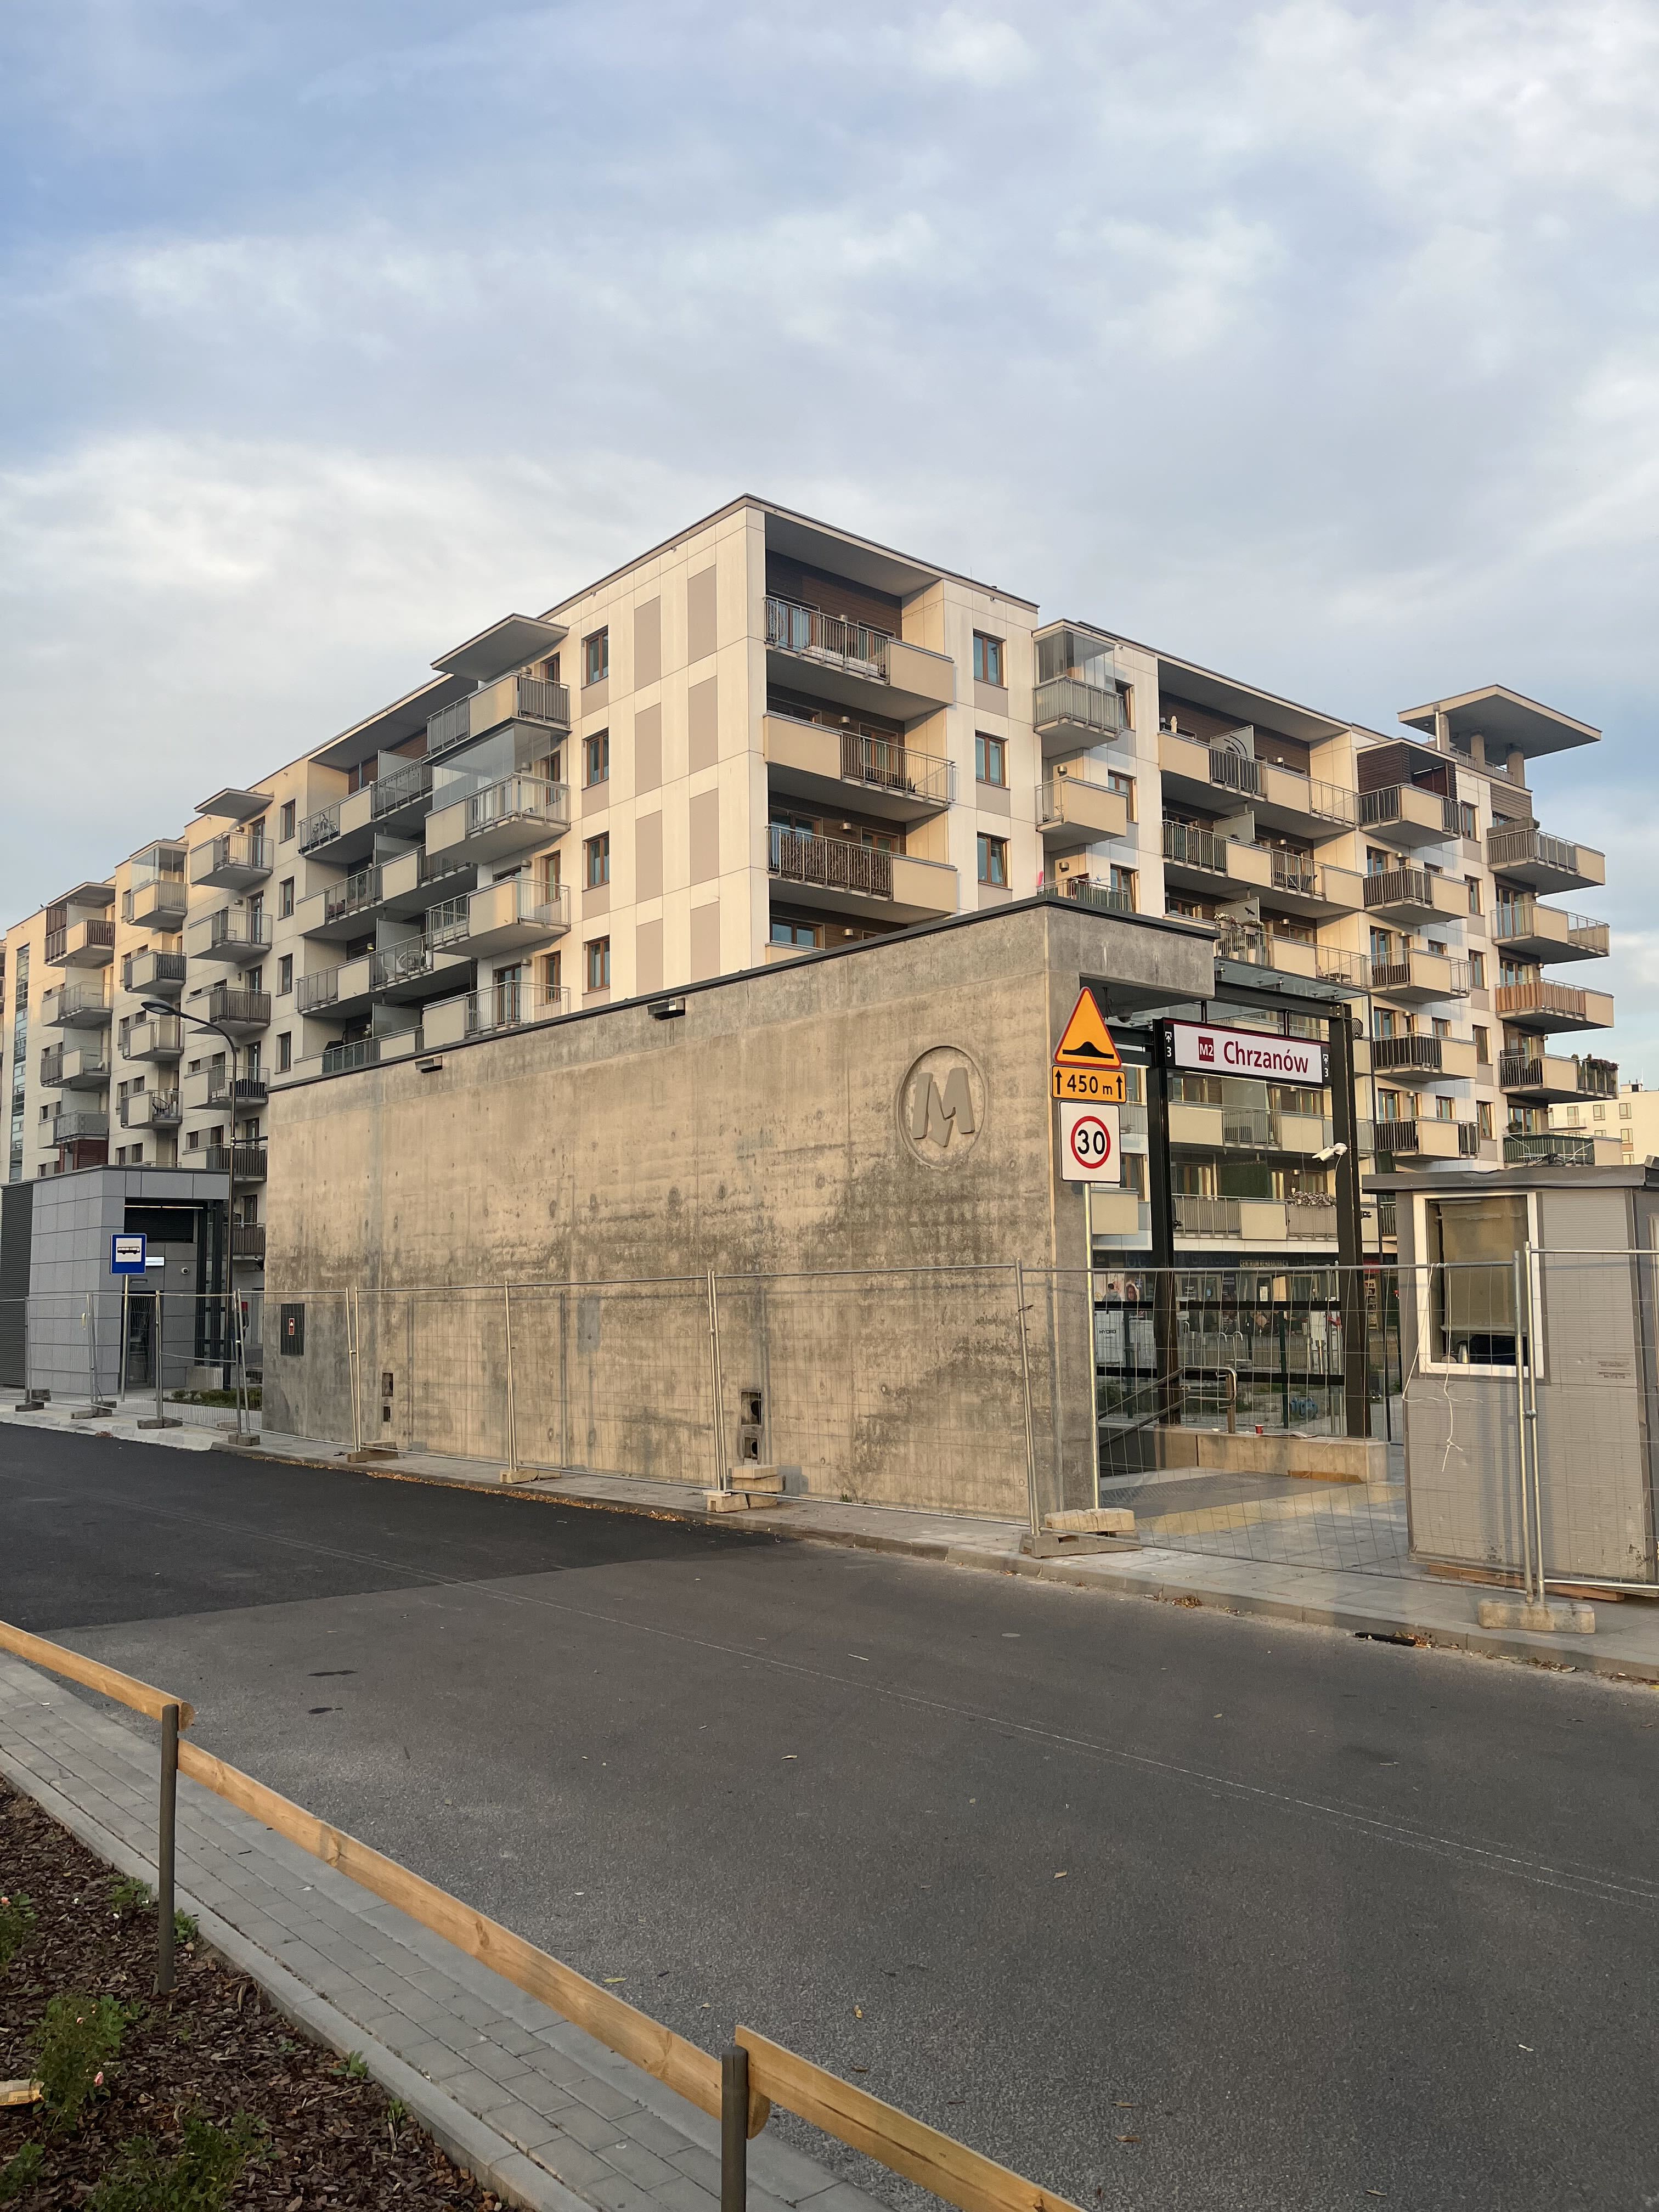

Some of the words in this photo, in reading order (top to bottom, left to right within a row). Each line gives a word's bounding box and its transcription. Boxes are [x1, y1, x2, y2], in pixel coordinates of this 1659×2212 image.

[1166, 1046, 1172, 1057] 3
[1199, 1043, 1214, 1057] M2
[1224, 1041, 1308, 1073] Chrzanów
[1324, 1068, 1329, 1077] 3
[1067, 1074, 1098, 1094] 450
[1102, 1085, 1113, 1095] m
[912, 1067, 975, 1148] M
[1077, 1129, 1105, 1155] 30
